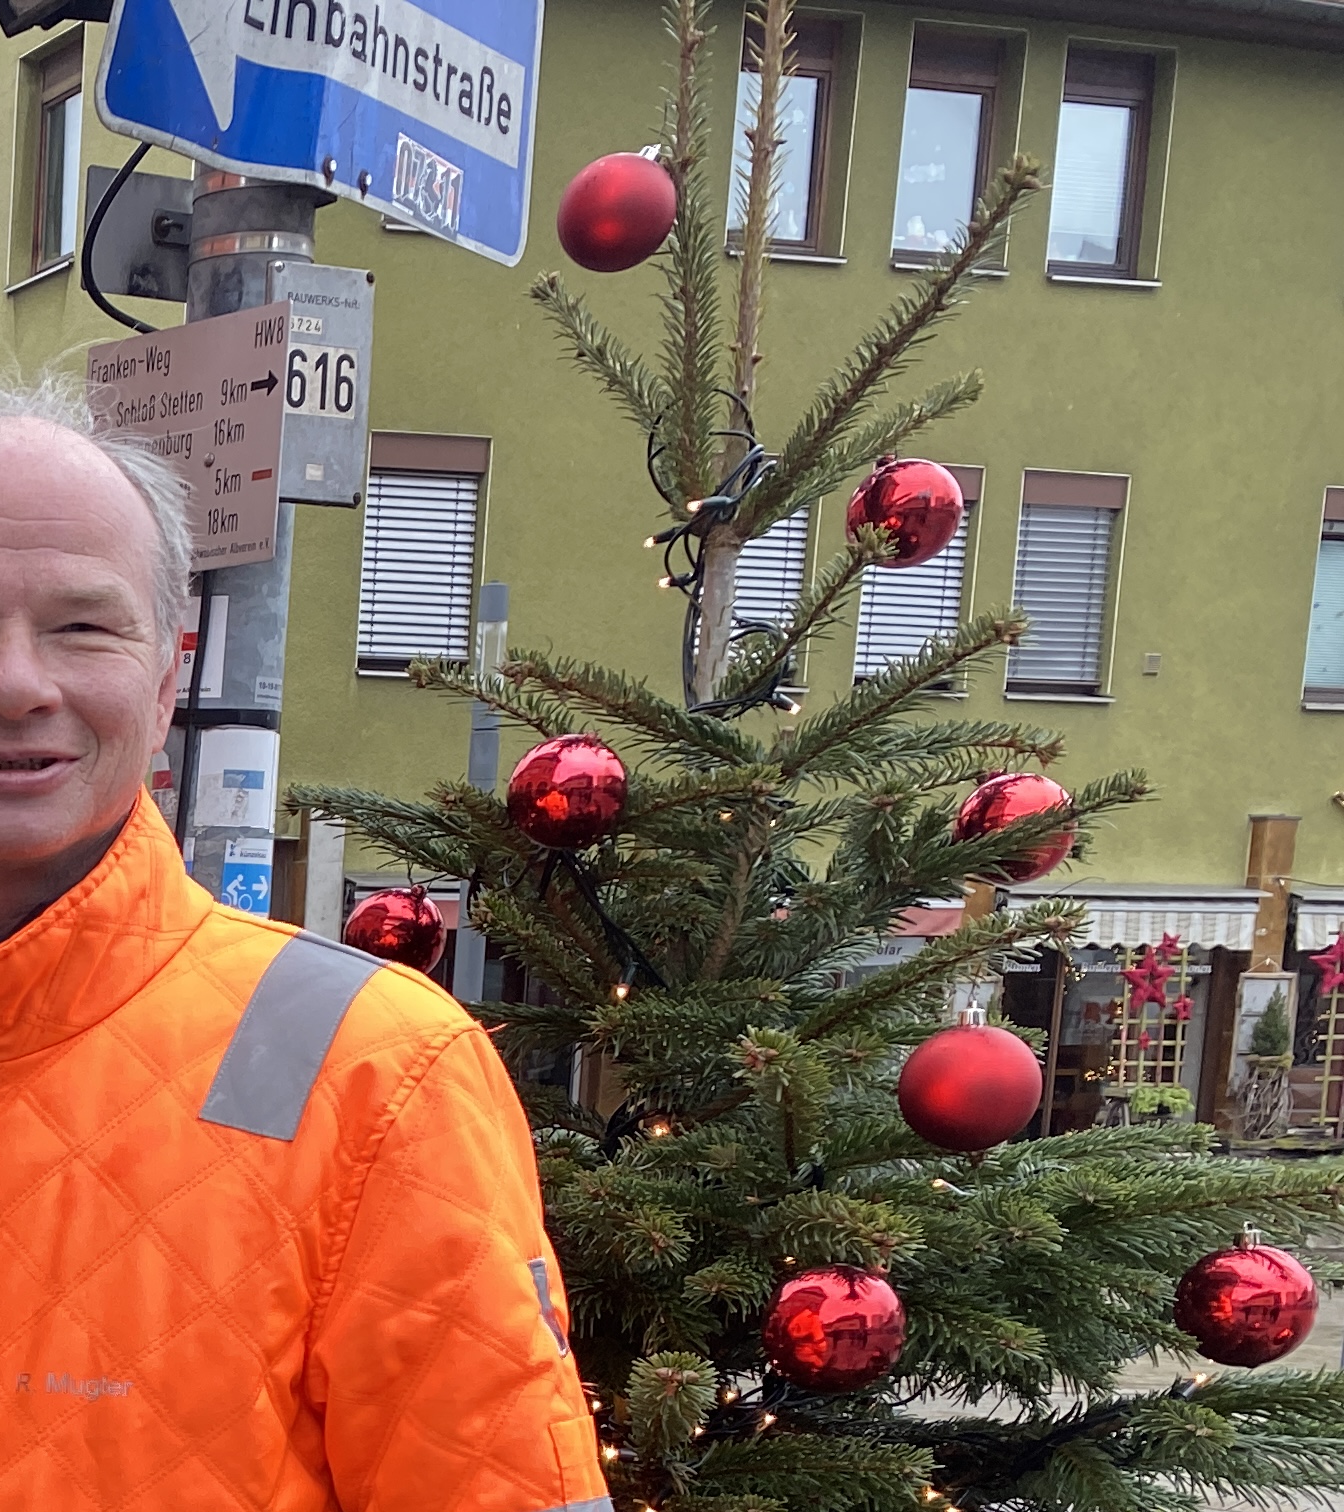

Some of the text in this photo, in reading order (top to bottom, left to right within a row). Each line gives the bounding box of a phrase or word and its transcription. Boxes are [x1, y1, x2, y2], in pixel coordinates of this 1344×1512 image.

[254, 316, 285, 350] HW8
[90, 349, 172, 384] Franken-Weg
[286, 348, 355, 413] 616
[116, 400, 156, 428] Schloß
[160, 391, 204, 419] Stetten
[213, 420, 245, 448] 16km
[214, 468, 242, 496] 5km
[207, 508, 239, 537] 18km
